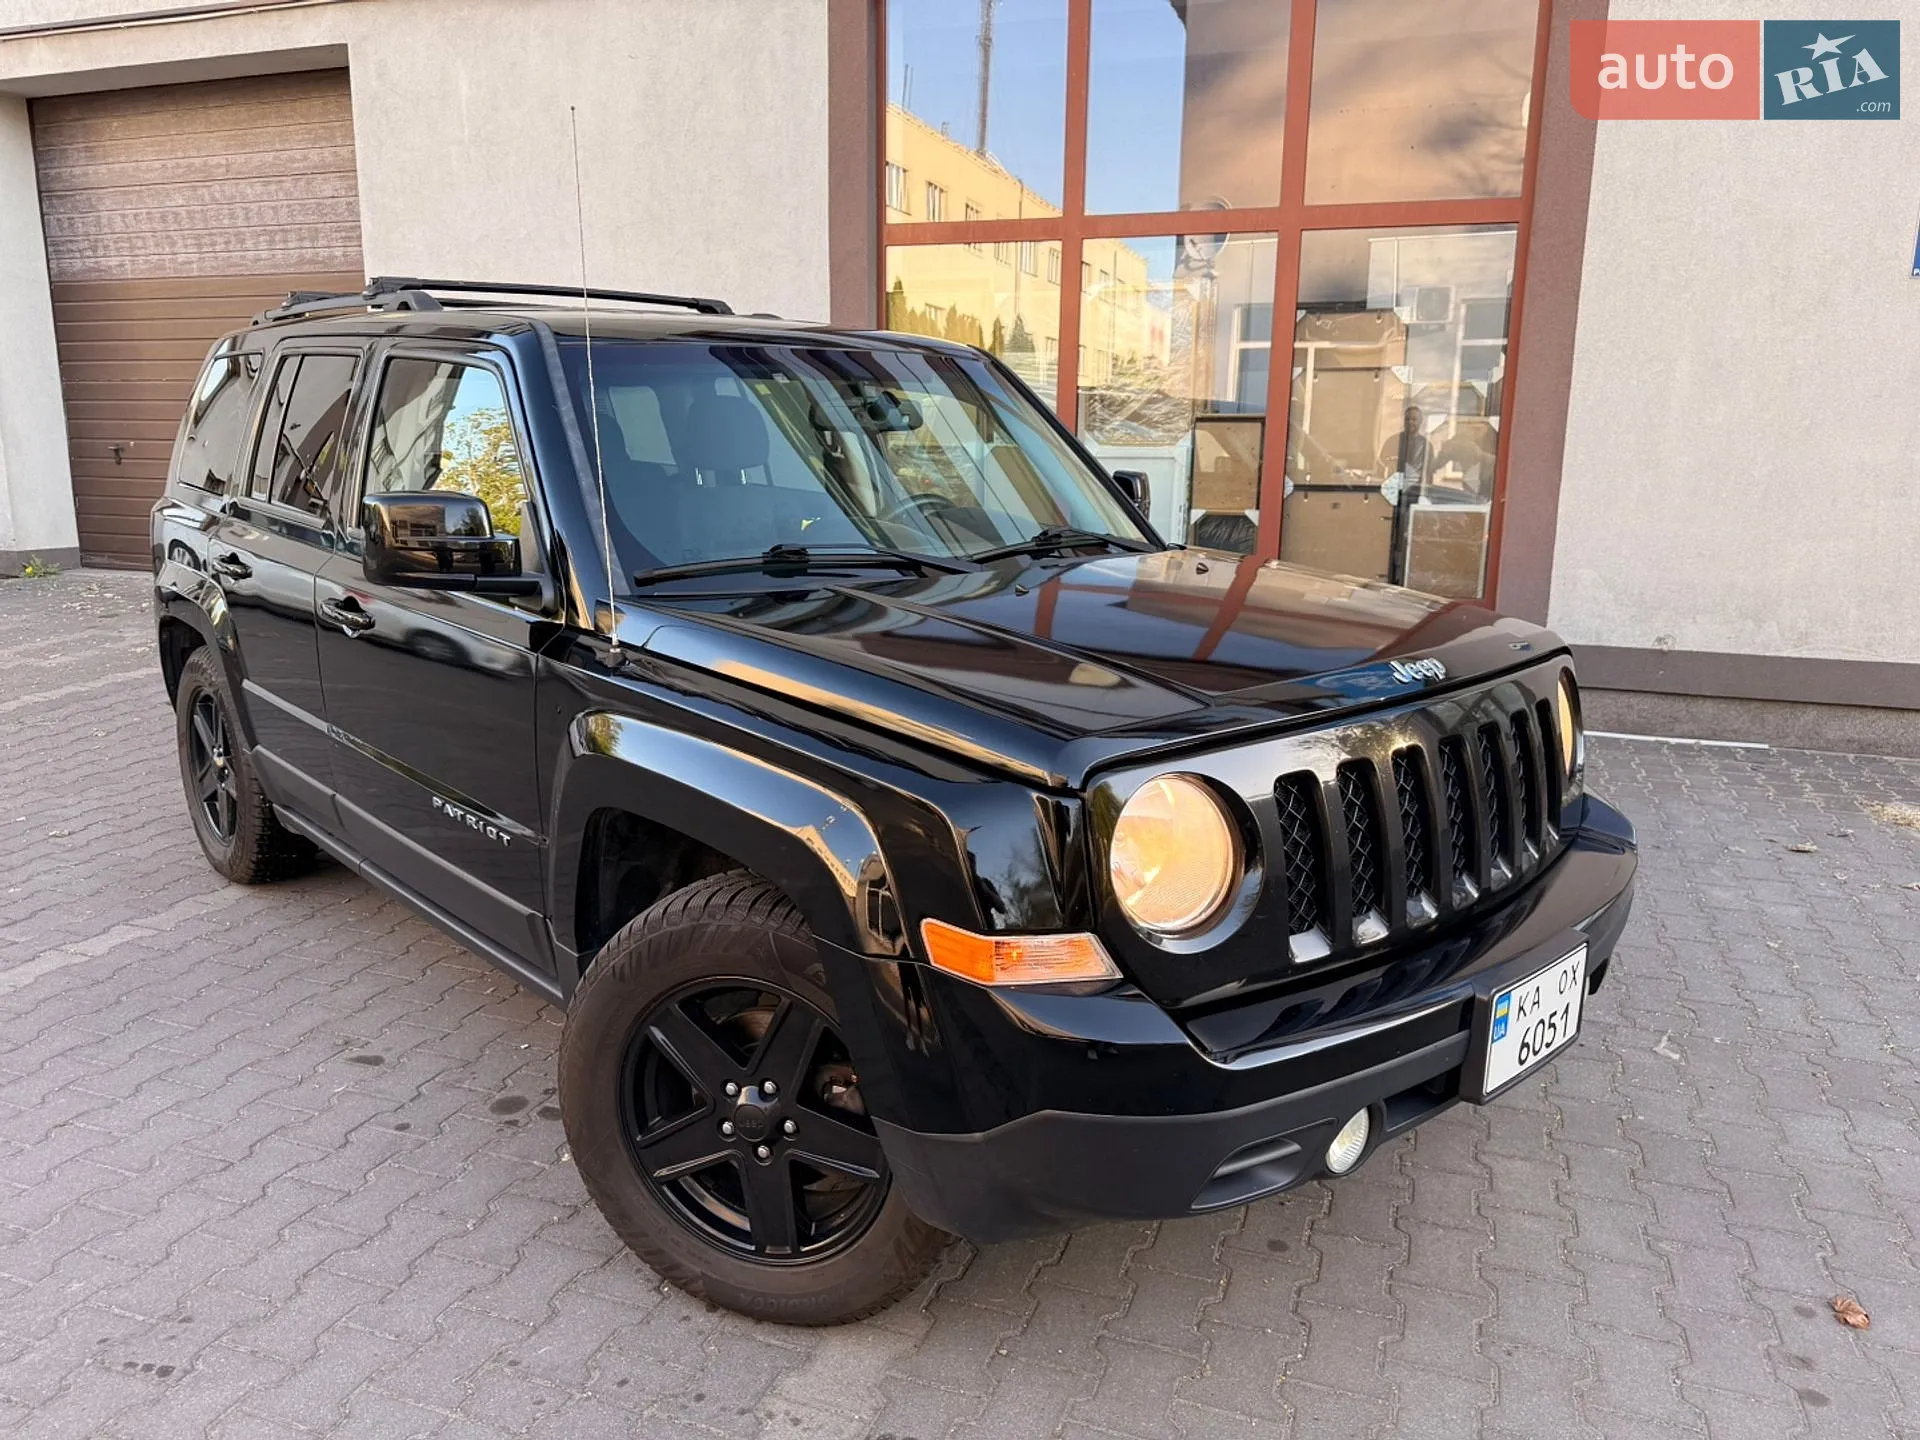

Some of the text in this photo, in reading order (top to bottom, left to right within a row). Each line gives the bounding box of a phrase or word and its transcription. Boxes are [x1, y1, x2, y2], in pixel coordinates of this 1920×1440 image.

[1389, 657, 1446, 684] Jeep
[432, 796, 511, 846] PATRIOT
[1516, 961, 1580, 1022] KA OX
[1493, 1022, 1506, 1040] UA
[1517, 1003, 1570, 1066] 6051
